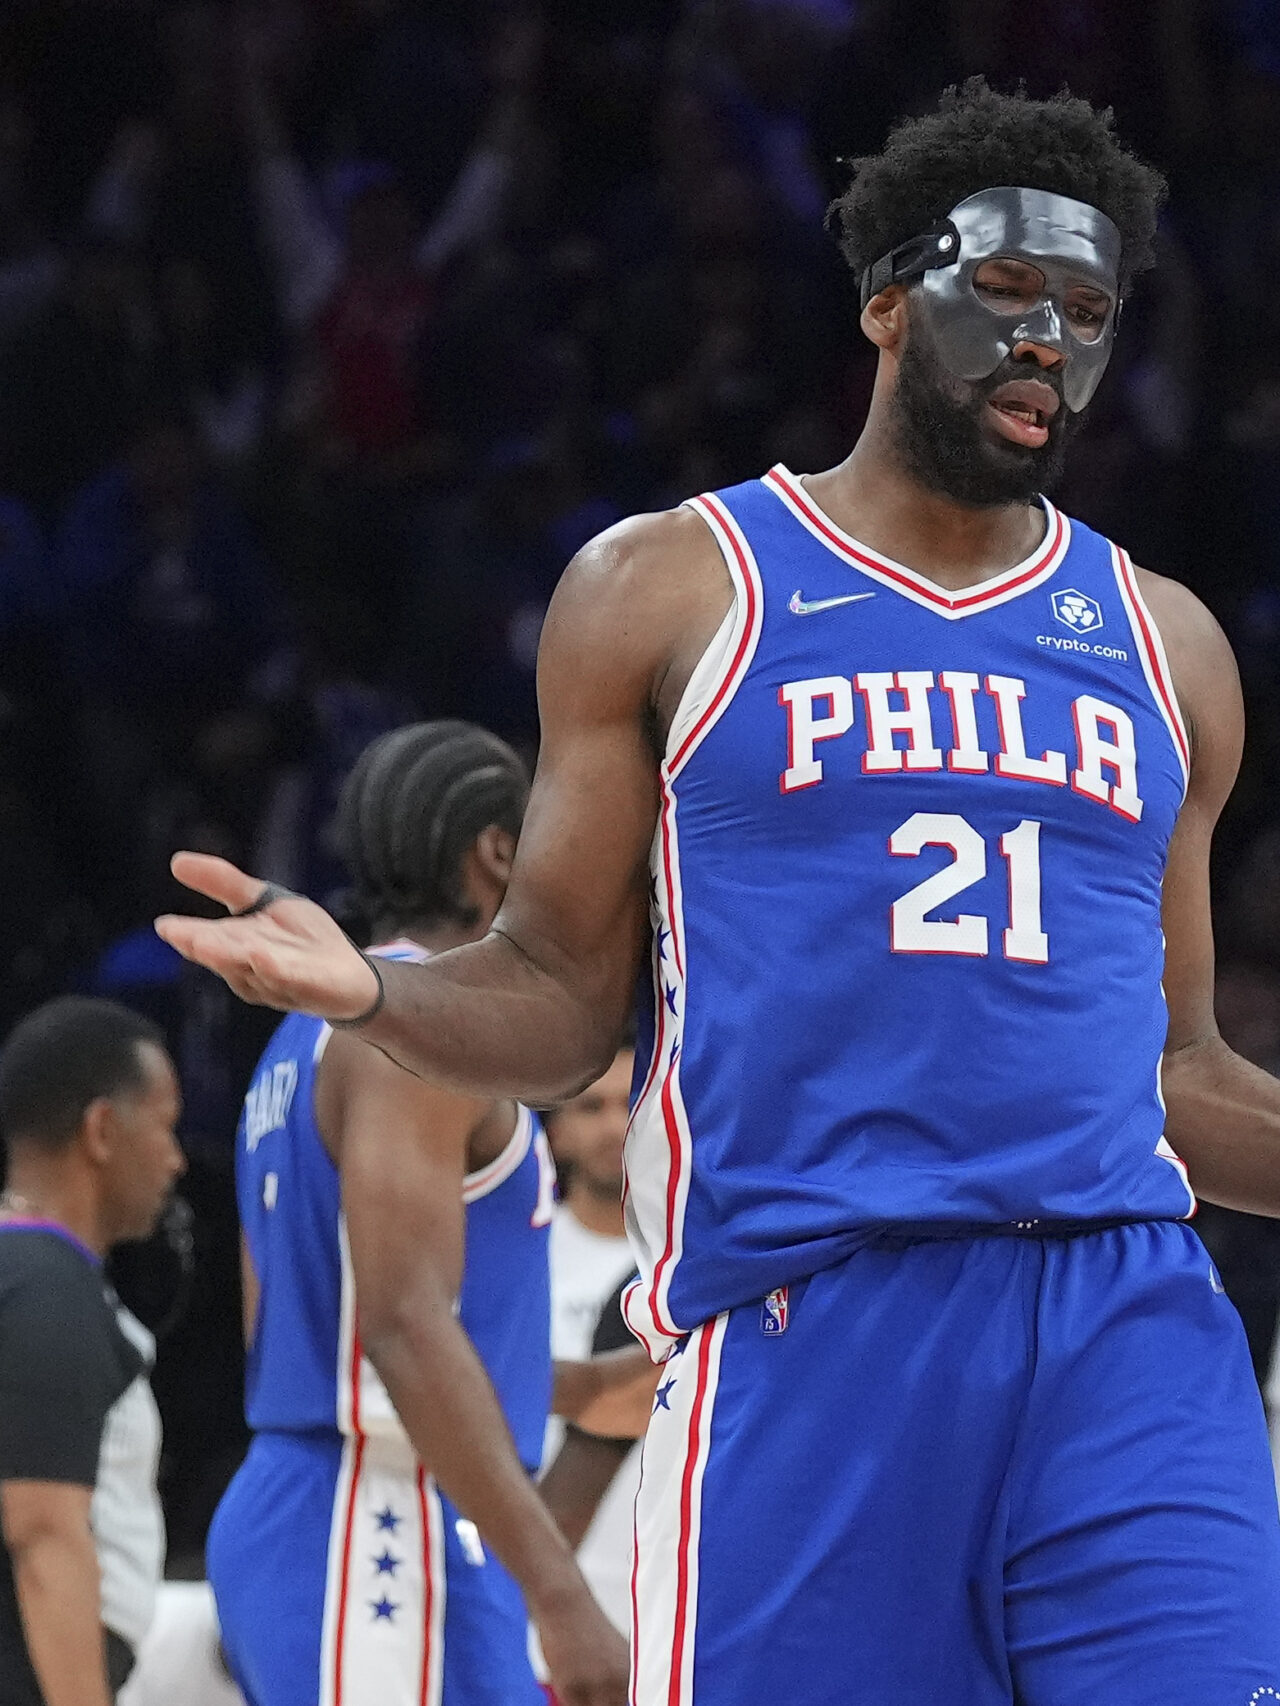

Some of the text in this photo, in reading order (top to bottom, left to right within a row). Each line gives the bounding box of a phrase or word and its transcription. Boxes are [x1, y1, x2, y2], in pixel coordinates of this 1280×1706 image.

[1036, 635, 1128, 661] crypto.com
[780, 671, 1143, 823] PHILA
[890, 813, 1048, 963] 21
